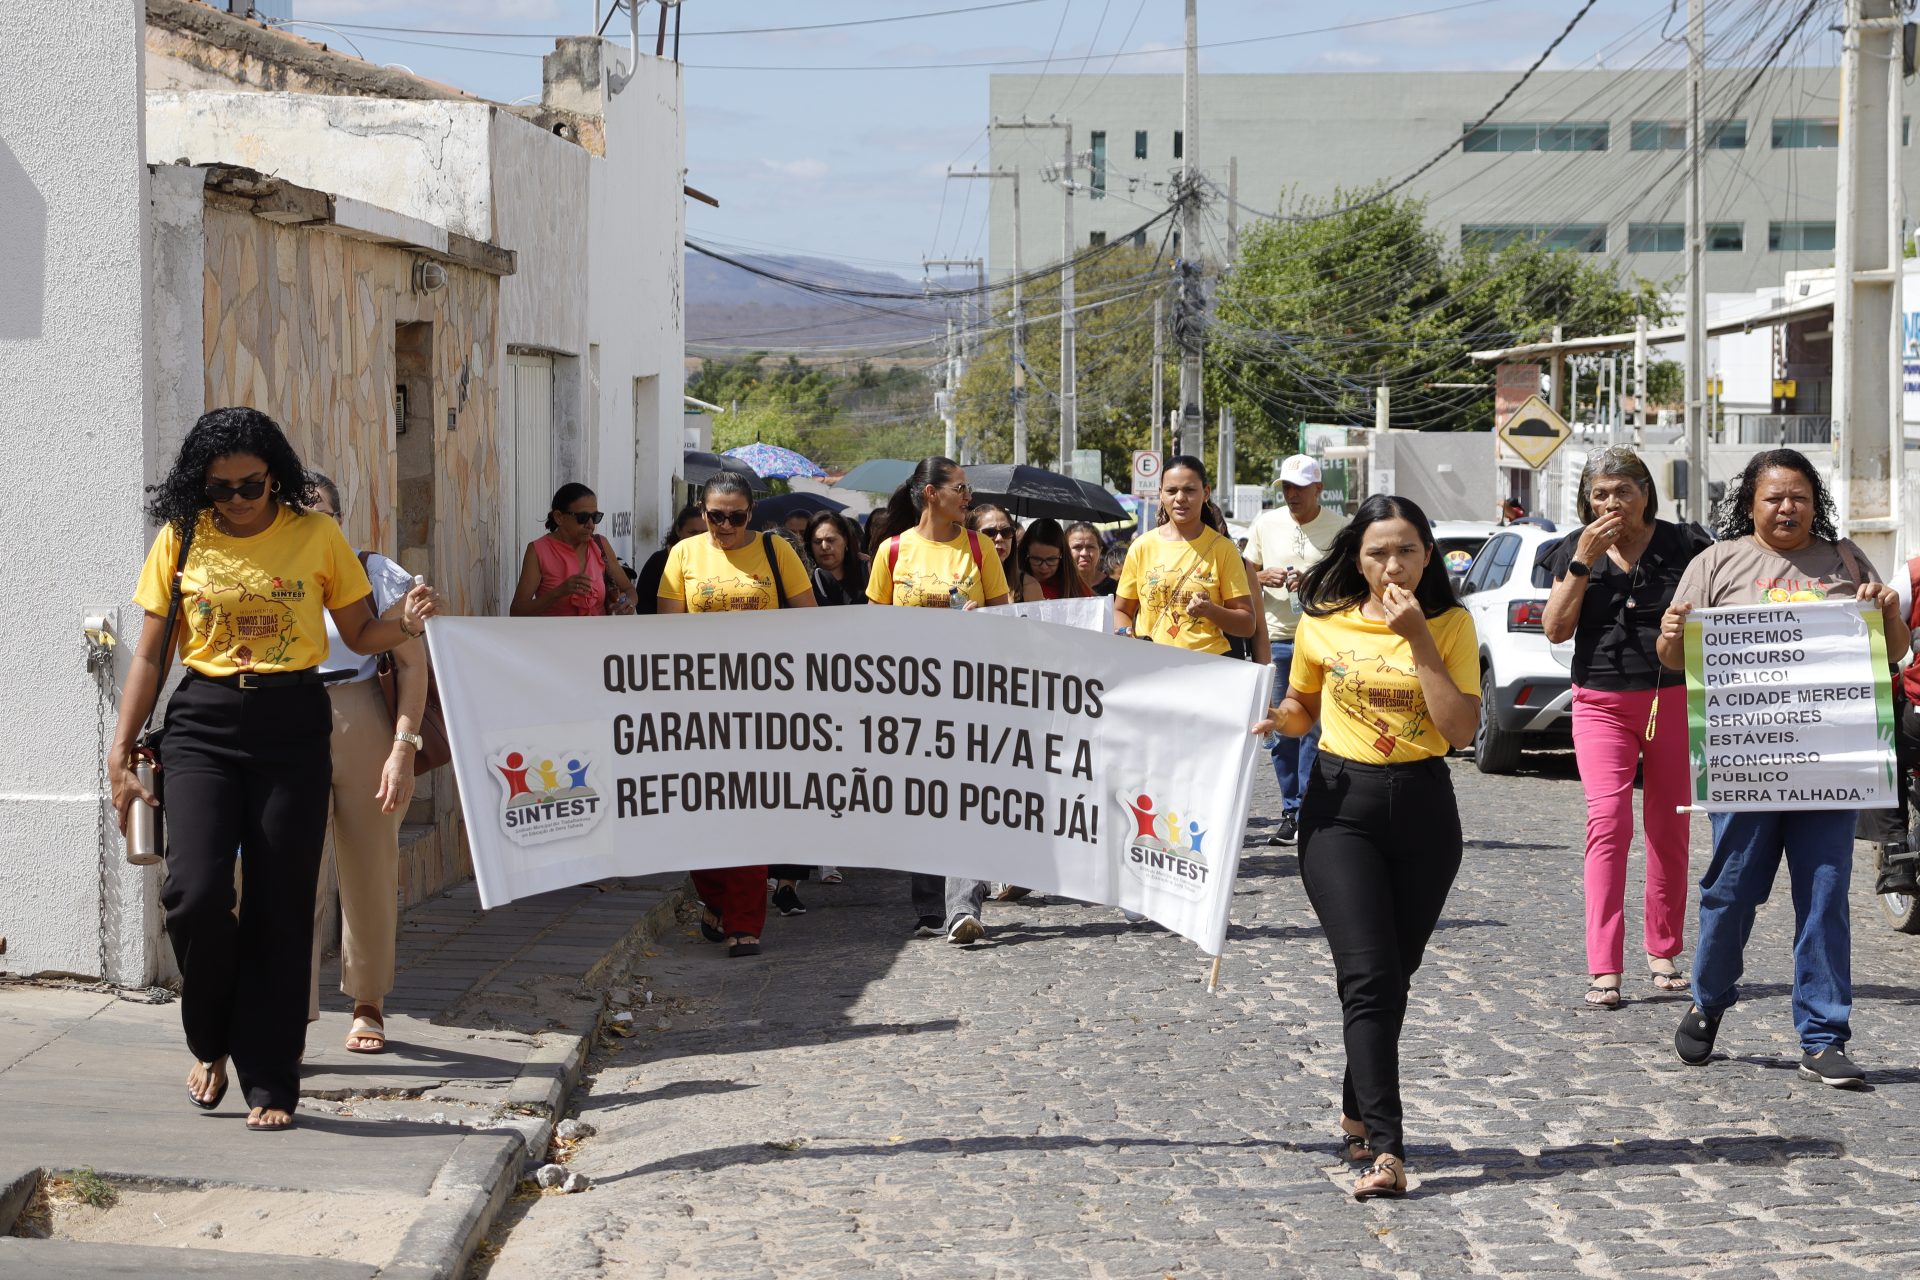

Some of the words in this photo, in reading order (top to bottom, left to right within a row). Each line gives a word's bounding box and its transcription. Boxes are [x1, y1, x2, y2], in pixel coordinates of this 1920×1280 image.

[1143, 459, 1151, 471] E
[1321, 489, 1344, 501] CANA
[236, 616, 258, 626] SOMOS
[260, 614, 278, 626] TODAS
[238, 624, 278, 636] PROFESSORAS
[1704, 628, 1803, 647] QUEREMOS
[1706, 649, 1805, 666] CONCURSO
[603, 652, 795, 693] QUEREMOS
[805, 652, 942, 698] NOSSOS
[953, 659, 1105, 718] DIREITOS
[1707, 670, 1789, 686] PÚBLICO!
[1368, 688, 1390, 698] SOMOS
[1392, 689, 1414, 700] TODAS
[1708, 695, 1721, 707] A
[1726, 690, 1791, 706] CIDADE
[1798, 686, 1871, 703] MERECE
[1368, 698, 1414, 708] PROFESSORAS
[1709, 710, 1822, 728] SERVIDORES
[1709, 730, 1800, 746] ESTÁVEIS.
[613, 711, 843, 756] GARANTIDOS:
[860, 715, 955, 760] 187.5
[967, 722, 1035, 770] H/A
[1045, 734, 1064, 774] E
[1072, 739, 1094, 782] A
[1709, 751, 1820, 769] #CONCURSO
[1711, 771, 1789, 782] PÚBLICO
[1712, 789, 1772, 802] SERRA
[505, 797, 600, 828] SINTEST
[616, 767, 893, 819] REFORMULAÇÃO
[904, 777, 949, 819] DO
[959, 782, 1044, 834] PCCR
[1054, 794, 1099, 845] JÁ!
[1130, 846, 1209, 884] SINTEST
